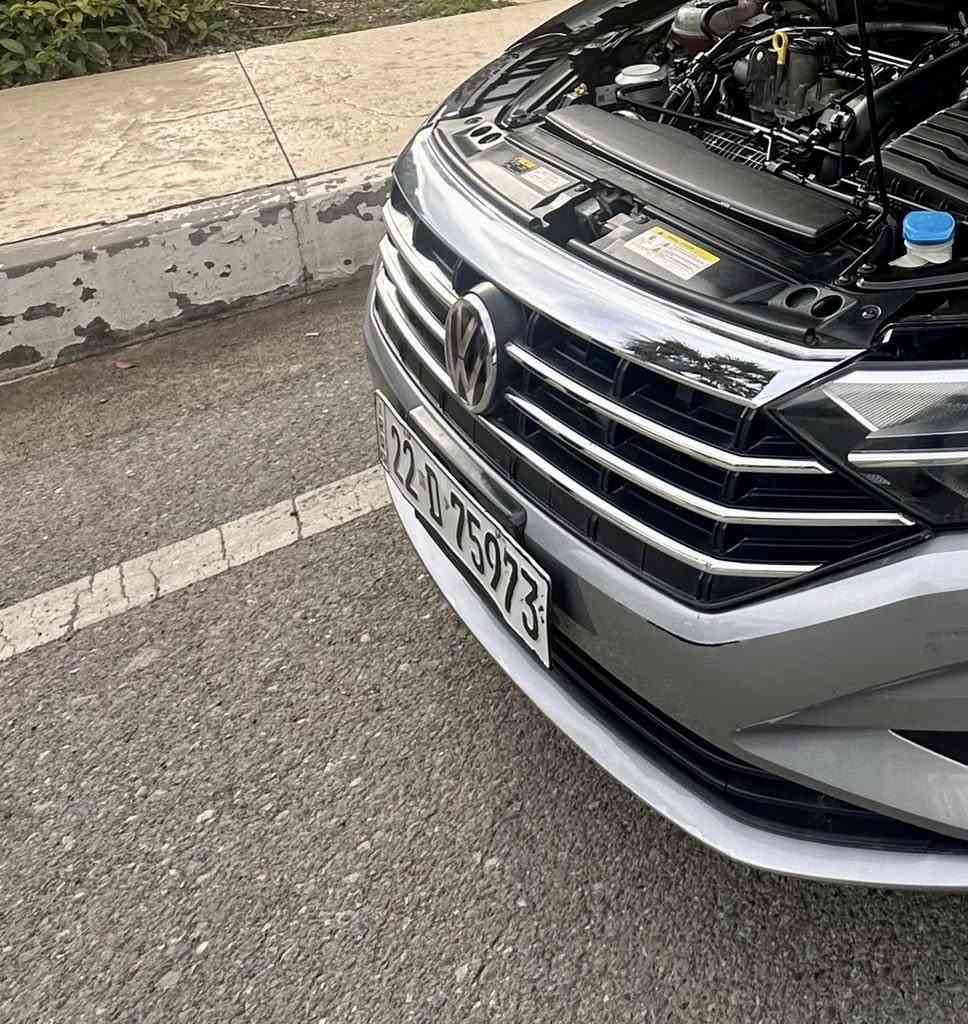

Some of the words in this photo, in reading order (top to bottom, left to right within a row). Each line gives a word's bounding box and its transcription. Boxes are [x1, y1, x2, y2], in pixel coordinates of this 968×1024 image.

[390, 425, 418, 500] 22
[425, 463, 443, 527] D
[450, 491, 539, 641] 75973
